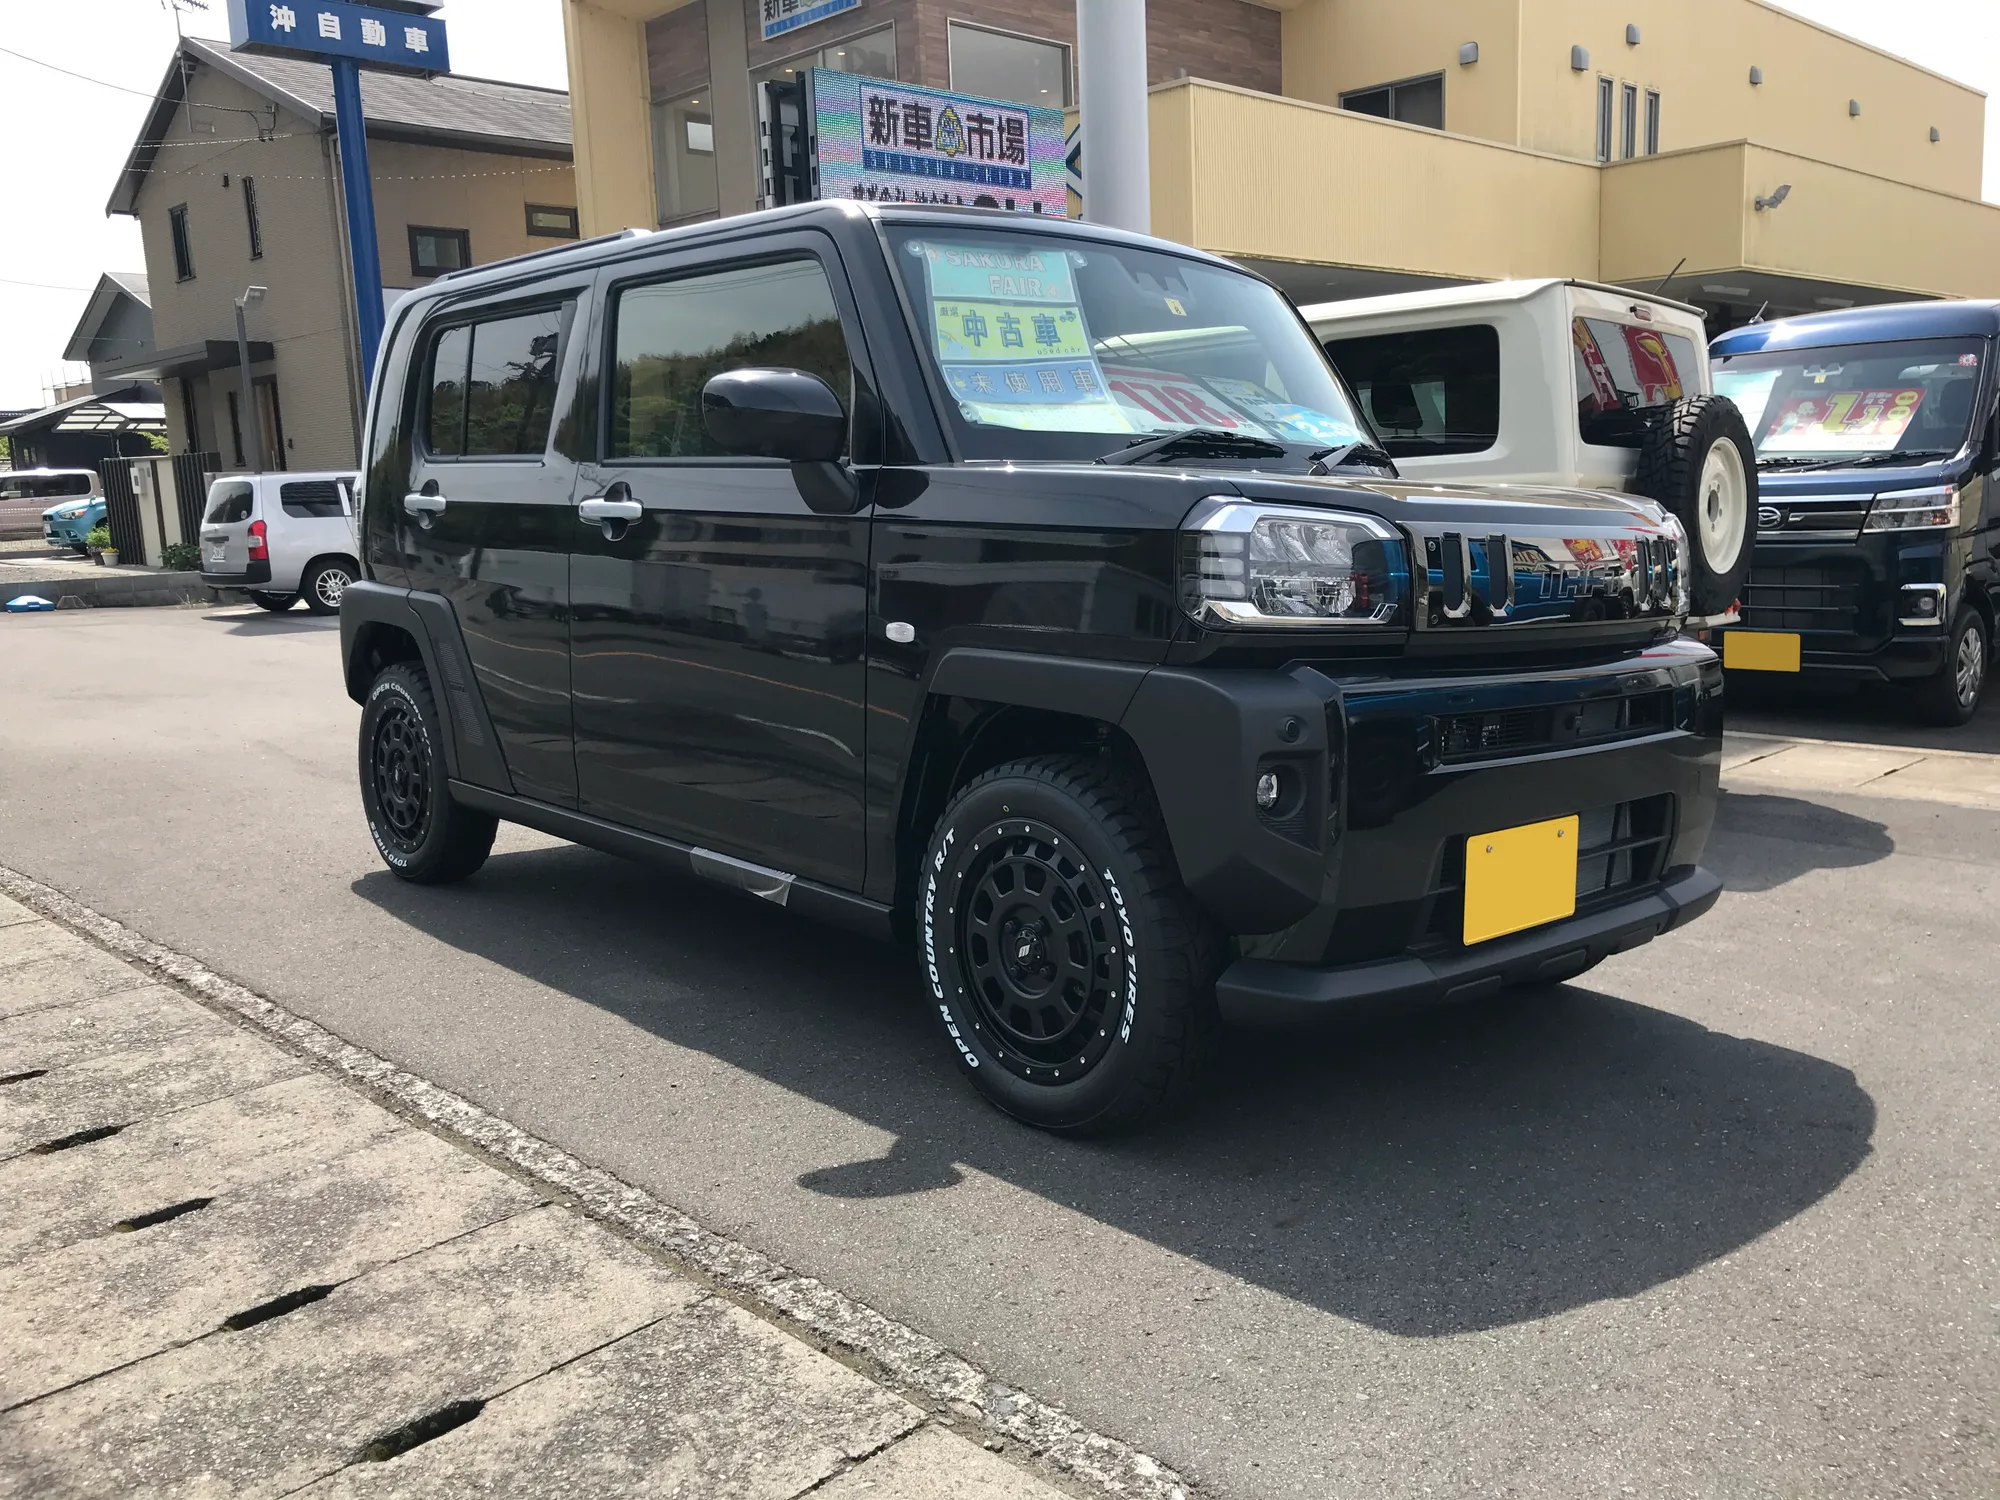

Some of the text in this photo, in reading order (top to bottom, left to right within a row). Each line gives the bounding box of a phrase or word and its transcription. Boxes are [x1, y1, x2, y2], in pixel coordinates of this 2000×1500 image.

[269, 4, 429, 53] 沖自動車
[945, 250, 1046, 272] SAKURA
[988, 274, 1044, 297] FAIR
[962, 309, 1061, 348] 中古車
[969, 367, 1098, 395] 未使用車
[372, 682, 390, 701] OPEN
[388, 853, 408, 867] TOYO
[924, 827, 980, 1068] OPEN COUNTRY R/T
[1103, 868, 1137, 1044] TOYO TIRES
